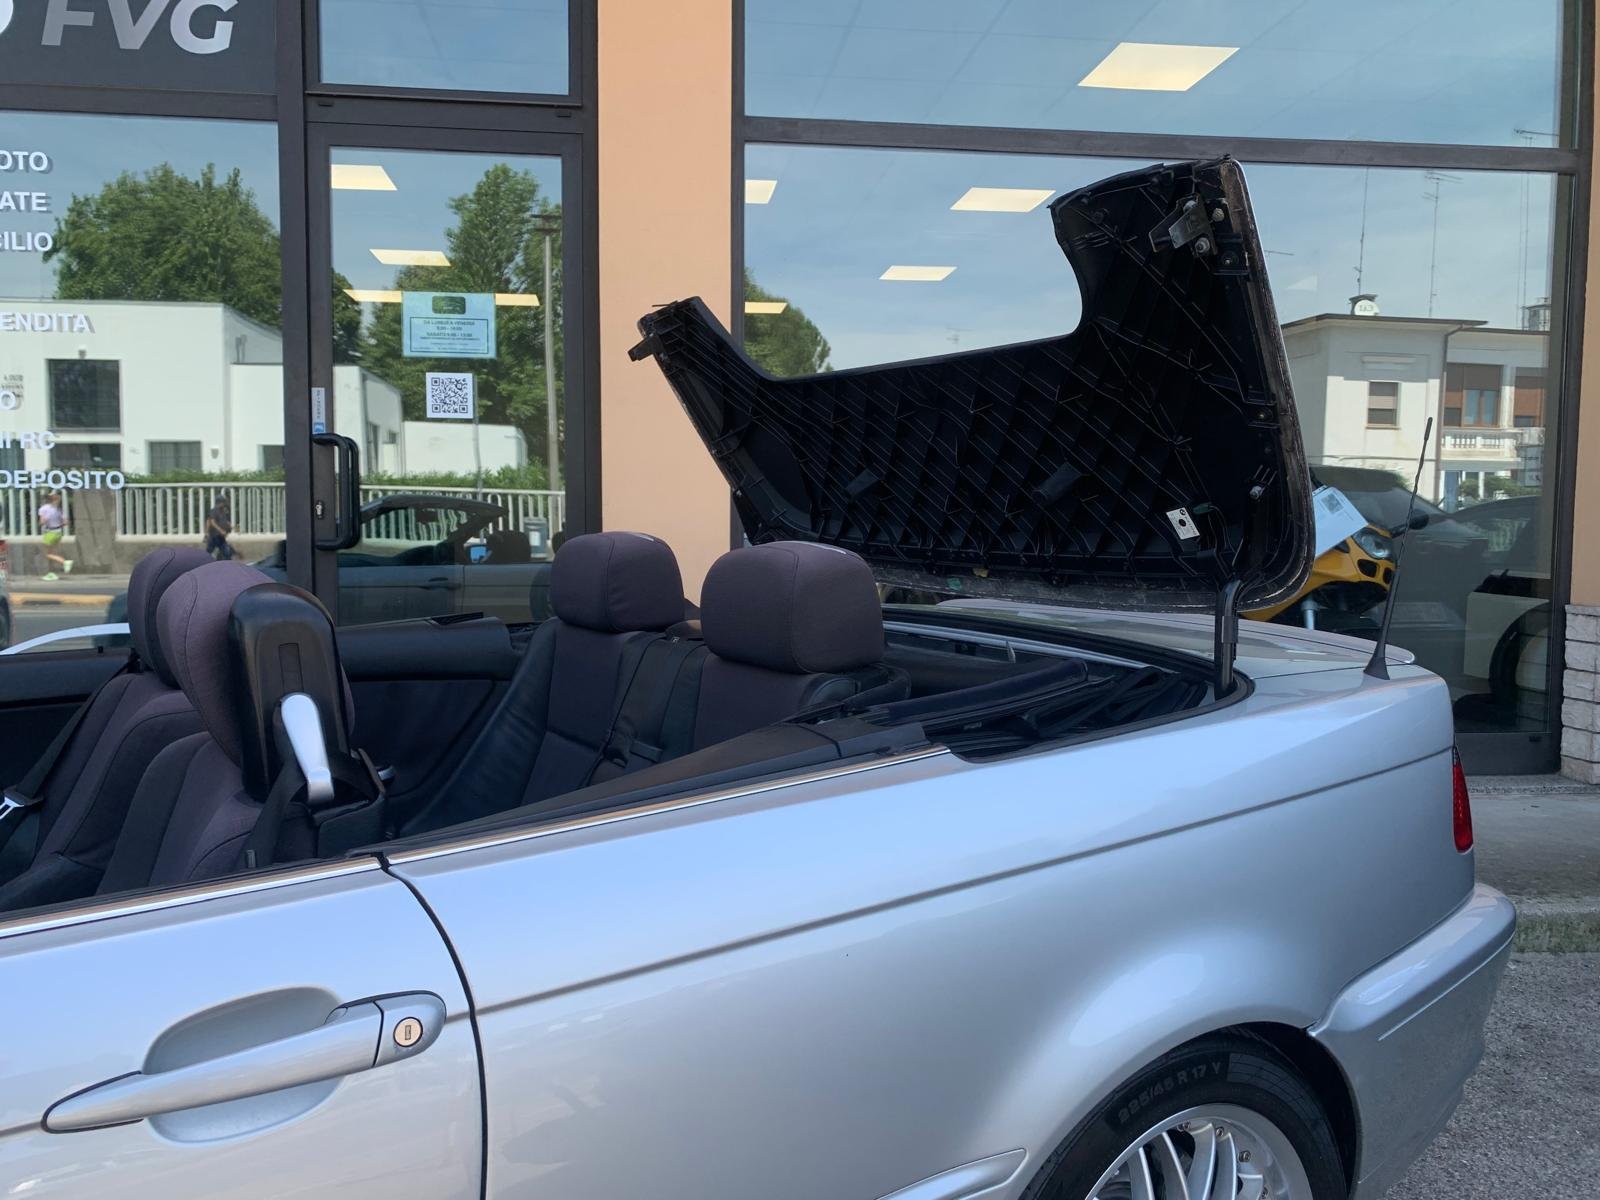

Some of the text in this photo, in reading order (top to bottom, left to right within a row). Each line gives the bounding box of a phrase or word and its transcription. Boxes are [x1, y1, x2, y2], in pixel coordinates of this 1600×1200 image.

[41, 0, 238, 54] FVG
[0, 150, 49, 172] OTO
[0, 191, 48, 212] ATE
[0, 231, 53, 252] ILIO
[0, 312, 91, 332] ENDITA
[20, 431, 56, 450] RC
[0, 470, 125, 490] DEPOSITO
[1177, 1070, 1189, 1085] R
[1192, 1065, 1207, 1080] 17
